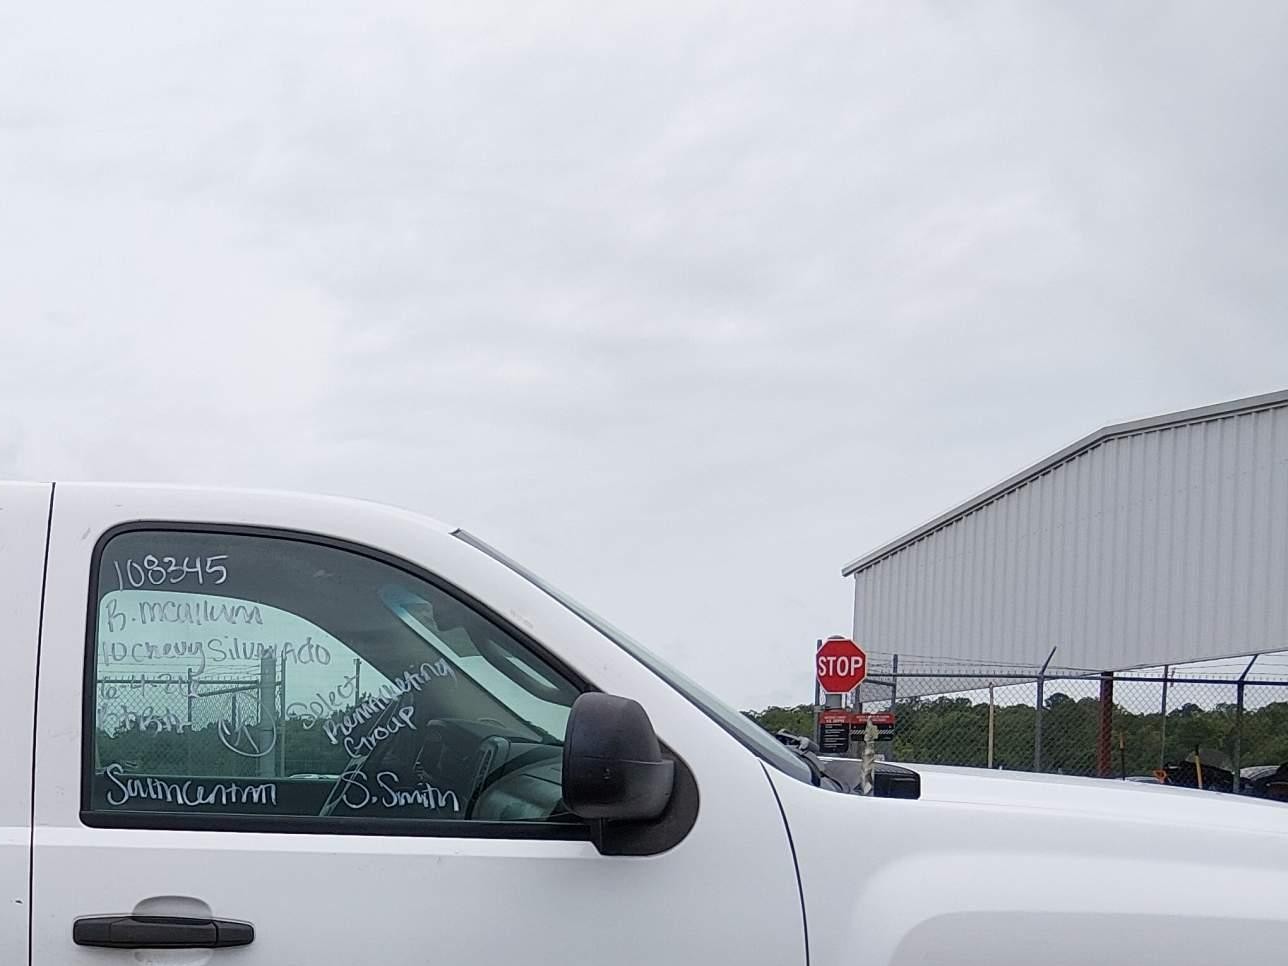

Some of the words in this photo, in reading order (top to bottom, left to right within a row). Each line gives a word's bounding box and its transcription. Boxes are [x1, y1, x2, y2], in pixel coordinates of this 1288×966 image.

[114, 555, 228, 591] 108345
[818, 657, 863, 676] STOP
[344, 706, 418, 759] Group
[381, 771, 459, 812] Smith
